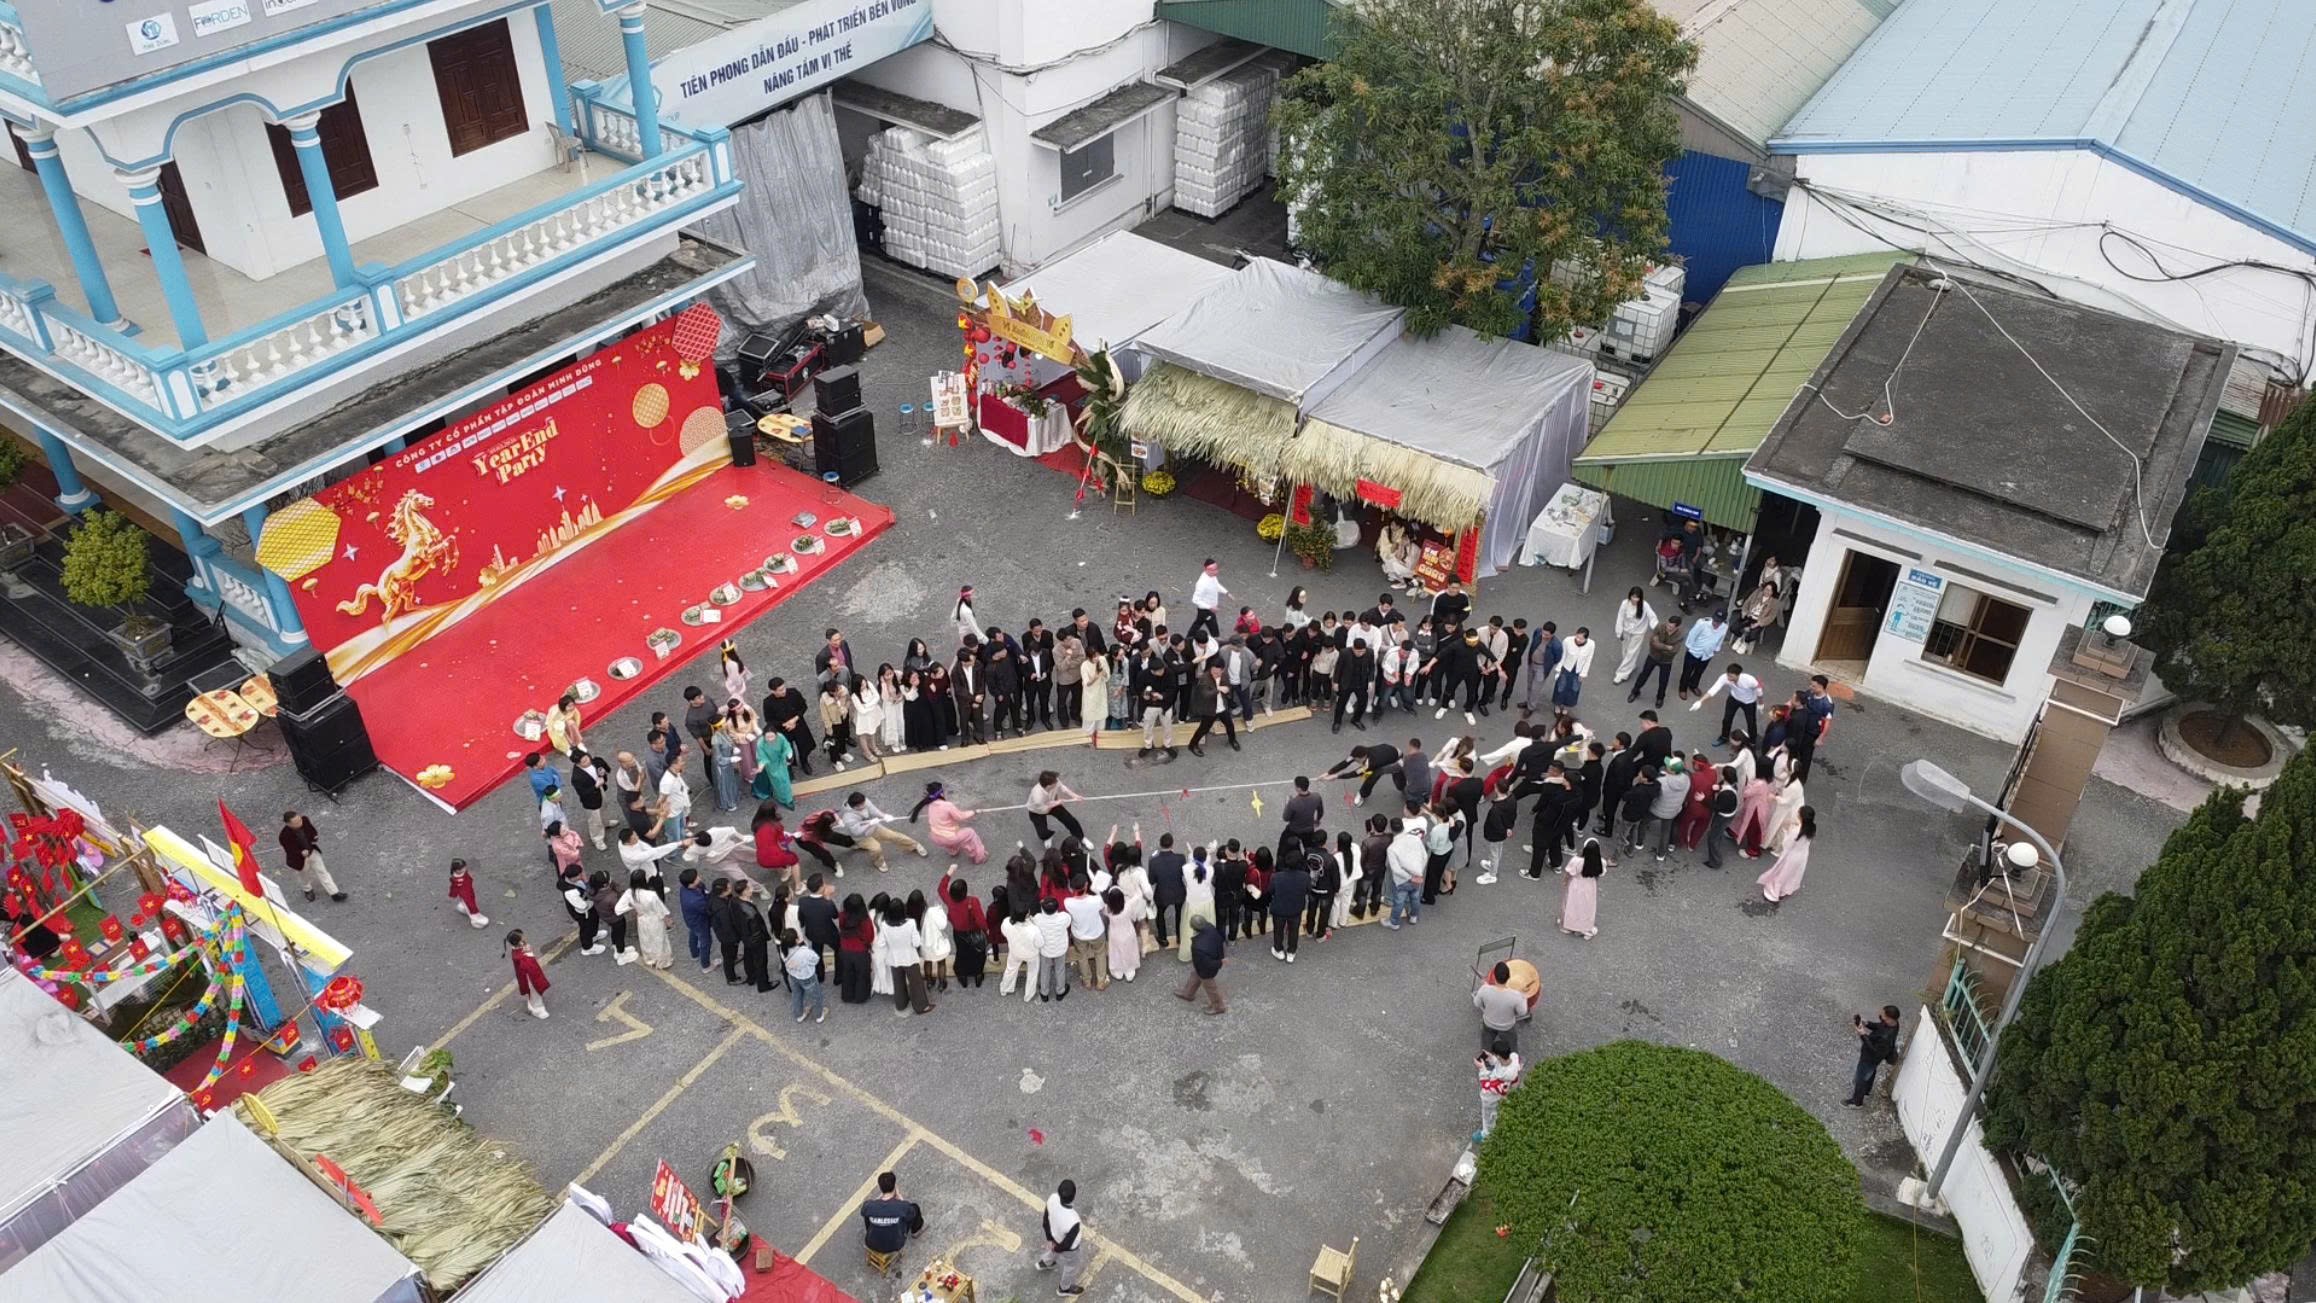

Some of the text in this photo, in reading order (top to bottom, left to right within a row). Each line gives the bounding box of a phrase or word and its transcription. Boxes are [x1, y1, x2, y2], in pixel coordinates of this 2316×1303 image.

[710, 57, 749, 87] PHONG
[808, 22, 835, 47] PHÁT
[428, 439, 442, 451] TY
[548, 373, 573, 390] MINH
[472, 443, 520, 476] Year
[520, 417, 558, 453] End
[498, 443, 546, 484] Party
